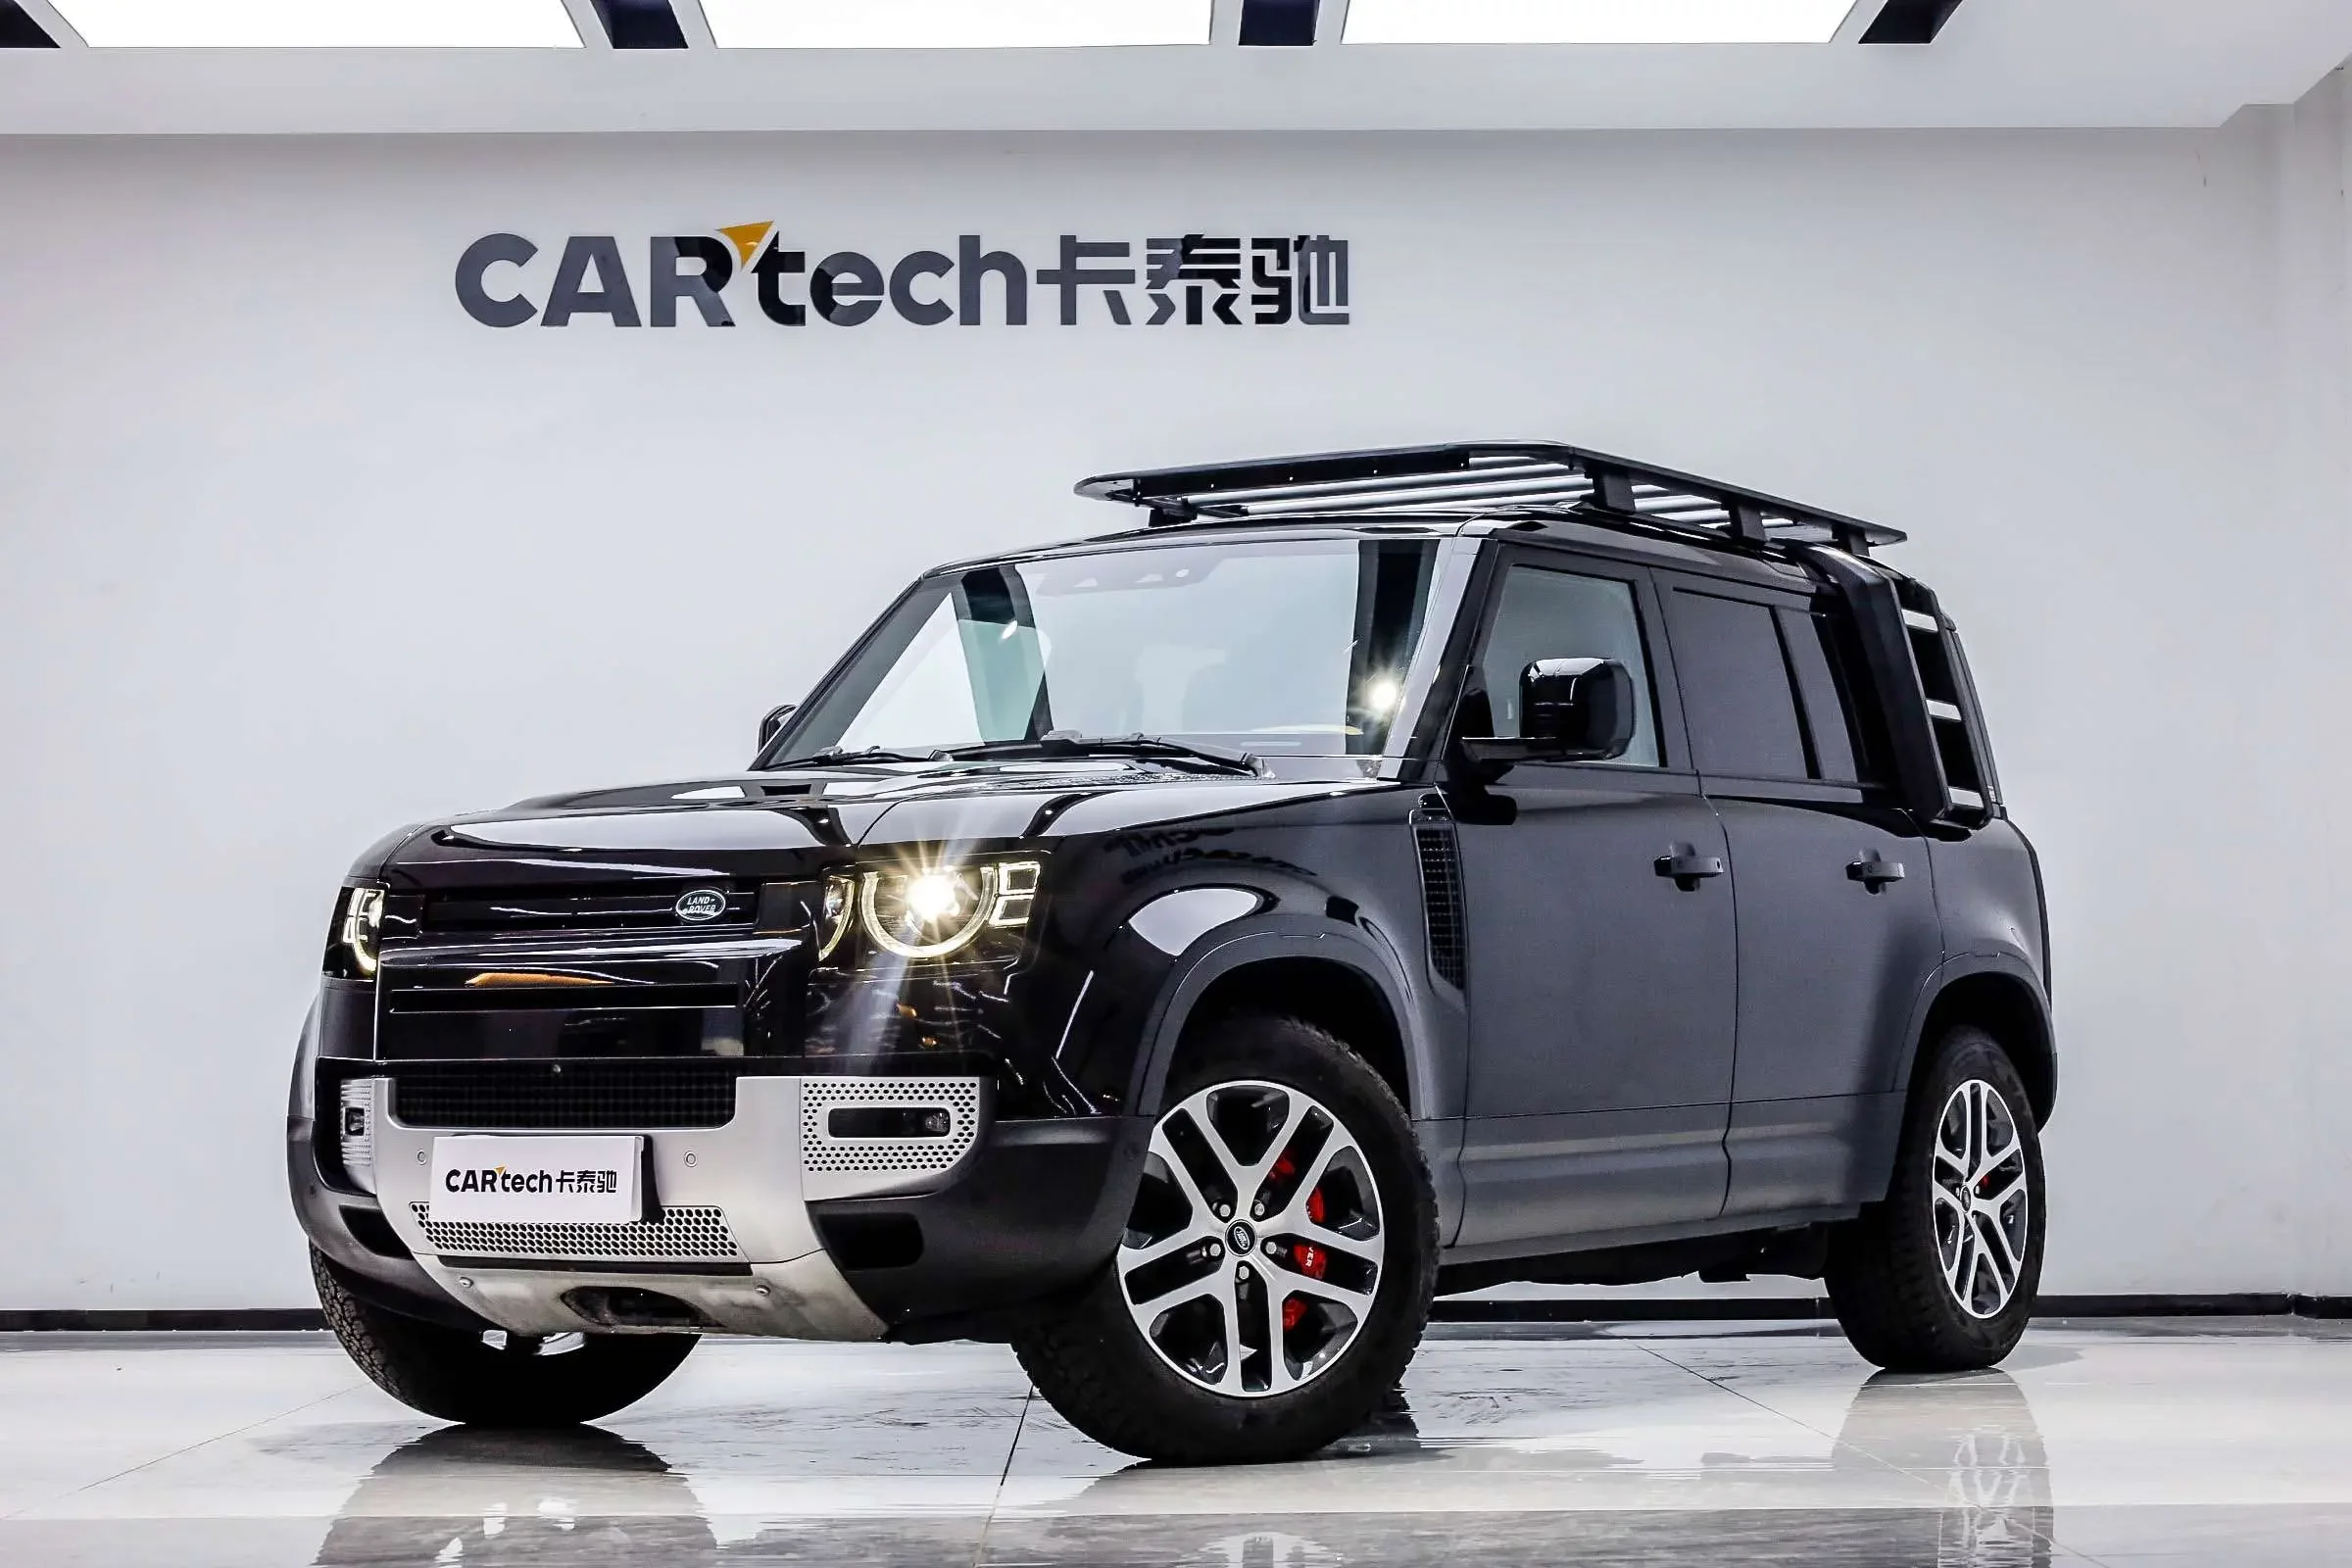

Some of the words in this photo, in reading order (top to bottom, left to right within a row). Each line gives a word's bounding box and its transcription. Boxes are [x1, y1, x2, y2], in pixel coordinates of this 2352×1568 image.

[456, 231, 1028, 328] CARtech
[1036, 233, 1350, 326] 卡泰驰
[445, 1168, 553, 1193] CARtech
[556, 1170, 617, 1194] 卡泰驰
